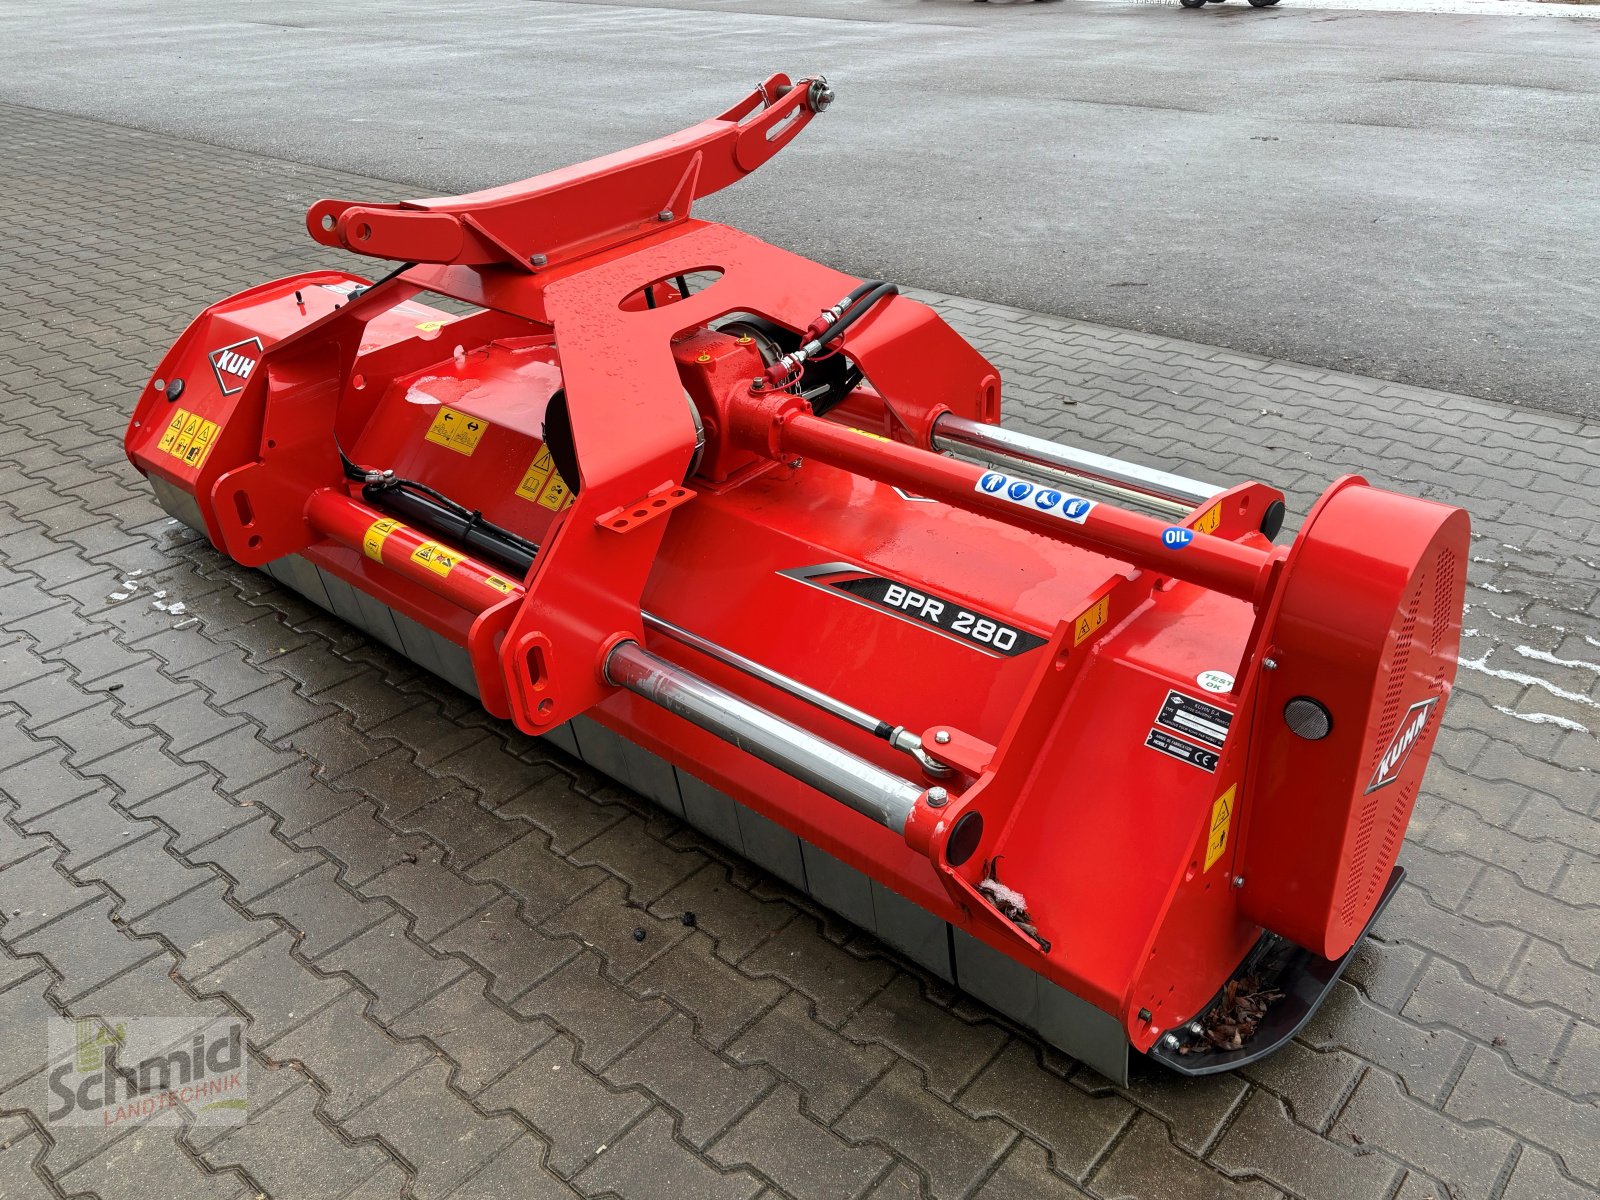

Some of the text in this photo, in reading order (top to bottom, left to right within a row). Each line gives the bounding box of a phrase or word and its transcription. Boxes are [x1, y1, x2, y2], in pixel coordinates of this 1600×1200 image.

[216, 349, 256, 379] KUH
[1165, 530, 1190, 544] OIL
[883, 584, 1018, 651] BPR 280
[1205, 673, 1234, 687] TEST
[1205, 681, 1222, 690] OK
[1194, 703, 1211, 713] KUHN
[1377, 704, 1429, 786] KUHN
[1194, 752, 1212, 766] CE
